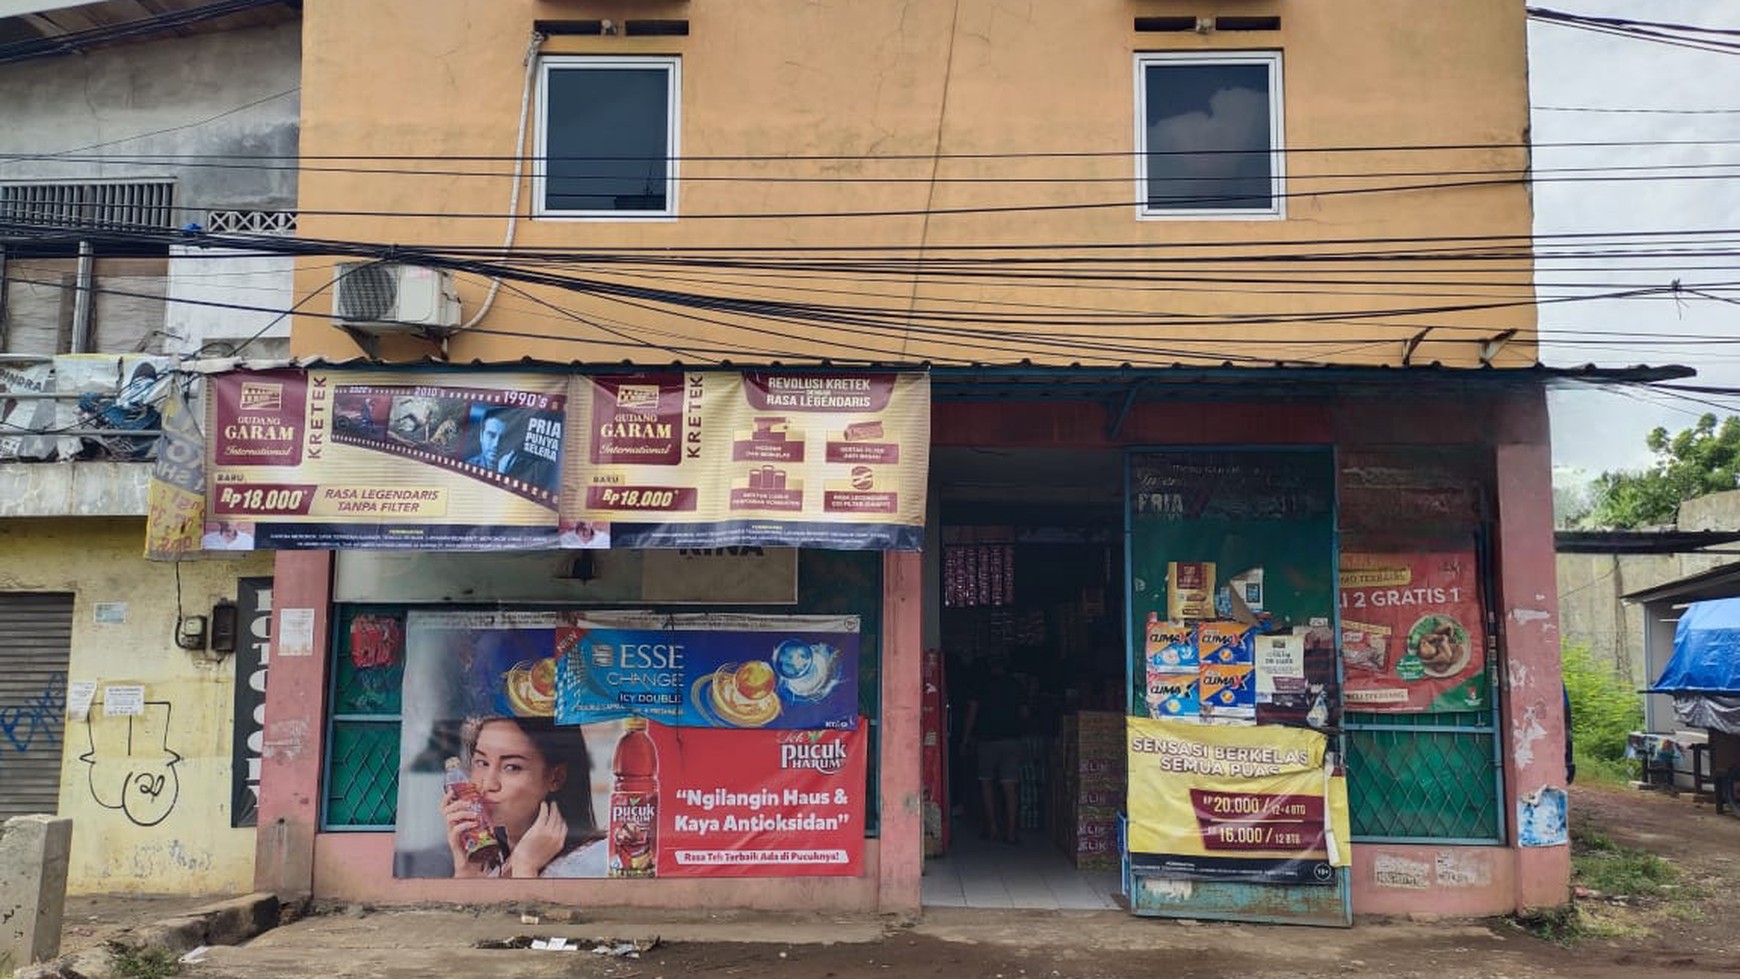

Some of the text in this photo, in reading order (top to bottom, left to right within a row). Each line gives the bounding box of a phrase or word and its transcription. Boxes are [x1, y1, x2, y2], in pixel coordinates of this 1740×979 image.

[768, 377, 871, 391] REVOLUSI KRETEK
[503, 390, 548, 409] 1990's
[766, 393, 871, 408] RASA LEGENDARIS
[238, 416, 281, 425] GUDANG
[307, 376, 327, 459] KRETEK
[615, 413, 657, 423] GUDANG
[687, 375, 704, 458] KRETEK
[224, 425, 295, 440] GARAM
[528, 417, 562, 437] PRIA
[601, 423, 673, 439] GARAM
[526, 432, 559, 451] PUNYA
[599, 443, 672, 454] International
[225, 445, 293, 456] International
[524, 442, 557, 462] SELERA
[324, 488, 439, 501] RASA LEGENDARIS
[337, 502, 420, 513] TANPA FILTER
[1353, 591, 1366, 608] 2
[1371, 587, 1446, 606] GRATIS
[1449, 587, 1460, 602] 1
[620, 644, 685, 669] ESSE
[607, 672, 685, 689] CHANGE
[620, 693, 681, 704] ICY DOUBLE
[782, 738, 847, 768] pucuk
[1132, 738, 1308, 766] SENSASI BERKELAS
[792, 759, 841, 770] HARUM
[1160, 757, 1224, 775] SEMUA
[783, 789, 830, 805] Haus
[834, 789, 848, 804] &
[1214, 797, 1260, 814] 20.000
[675, 815, 720, 832] Kaya
[1220, 827, 1263, 843] 16.000
[684, 853, 840, 862] Rasa Teh Terbaik Ada di Pucuknya!
